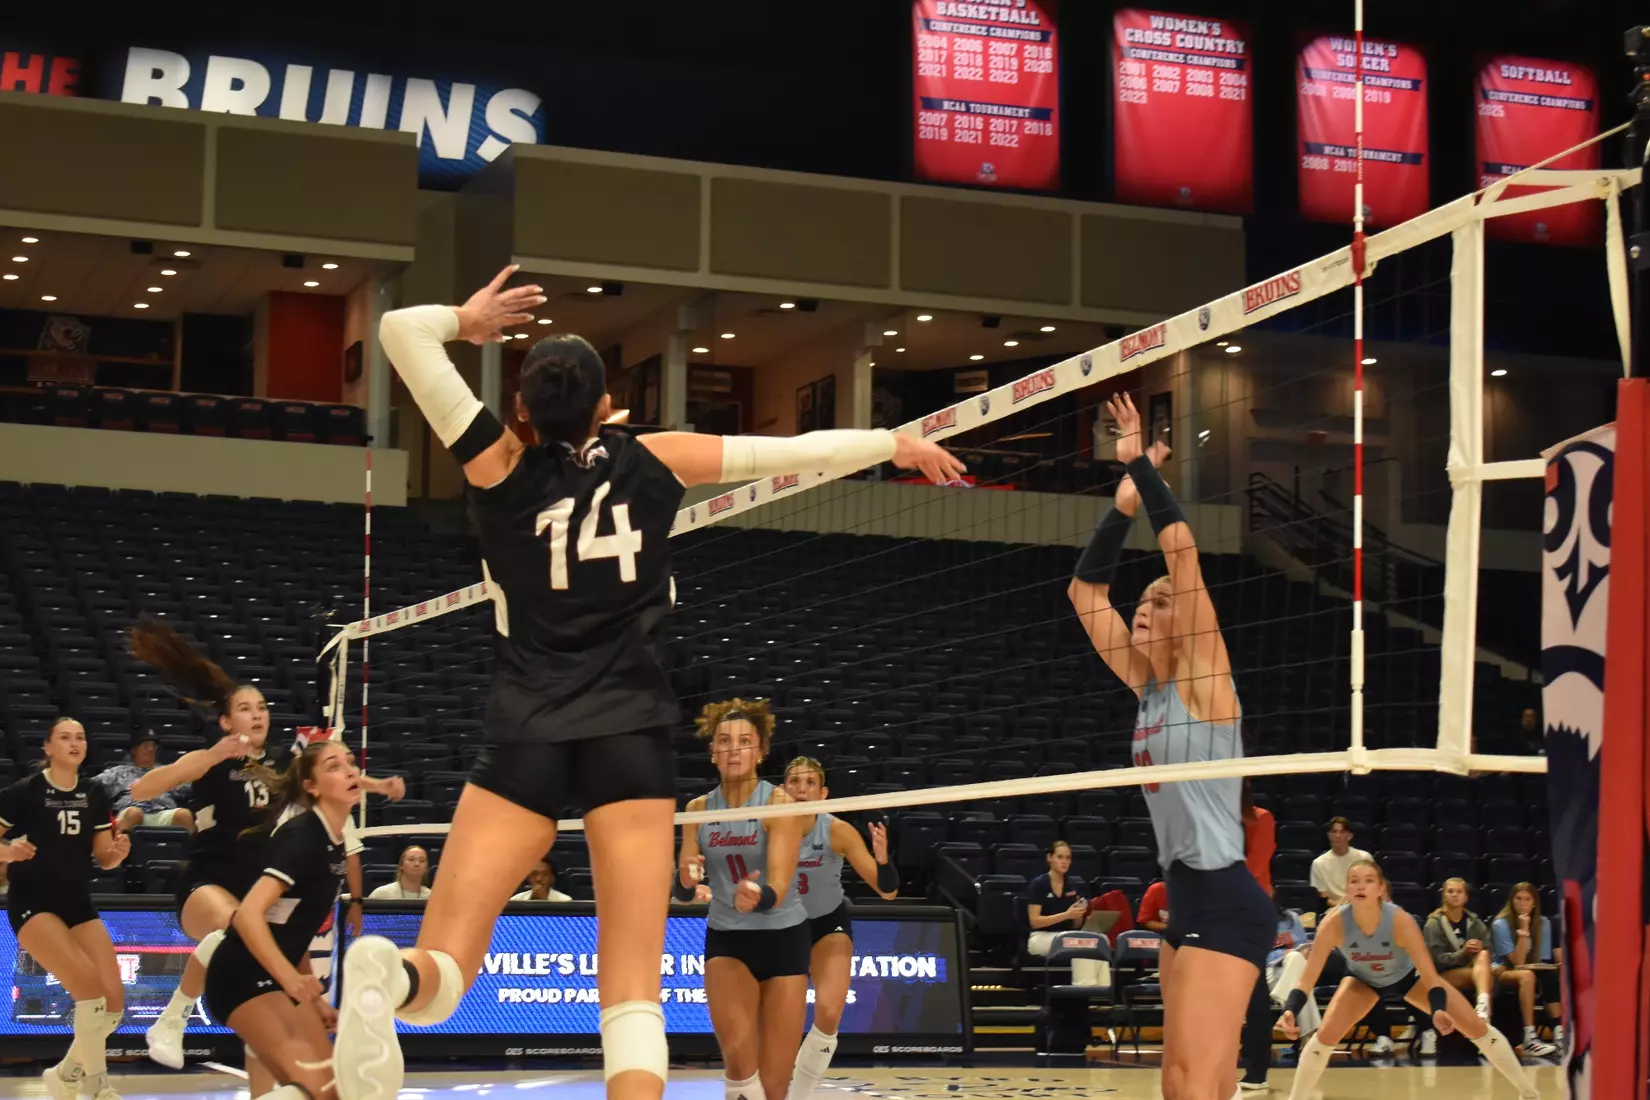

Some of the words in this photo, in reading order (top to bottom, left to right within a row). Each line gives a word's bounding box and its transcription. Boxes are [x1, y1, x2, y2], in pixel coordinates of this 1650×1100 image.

[936, 2, 1040, 25] BASKETBALL
[929, 21, 987, 36] CONFERENCE
[990, 27, 1042, 41] CHAMPIONS
[1151, 15, 1221, 36] WOMEN'S
[1125, 28, 1171, 46] CROSS
[1176, 34, 1245, 54] COUNTRY
[1130, 48, 1185, 63] CONFERENCE
[1187, 54, 1237, 68] CHAMPIONS
[1336, 53, 1390, 72] SOCER
[1365, 75, 1413, 89] CHAMPIONS
[1501, 64, 1572, 85] SOFTBALL
[121, 46, 541, 162] BRUINS
[942, 100, 966, 112] NCAA
[969, 103, 1030, 118] TOURNAMENT
[1488, 91, 1539, 105] CONFERENCE
[1540, 96, 1586, 110] CHAMPIONS
[919, 112, 947, 126] 2007
[954, 115, 983, 129] 2016
[989, 119, 1018, 132] 2017
[954, 129, 982, 143] 2021
[990, 133, 1019, 148] 2022
[1243, 270, 1301, 314] BRUINS
[535, 481, 642, 589] 14
[244, 780, 270, 808] 13
[57, 810, 81, 835] 15
[708, 830, 758, 848] Belmont
[726, 854, 748, 884] 11
[797, 856, 823, 868] mont
[478, 953, 575, 976] VILLE'S
[498, 988, 562, 1003] PROUD
[673, 988, 709, 1003] THE
